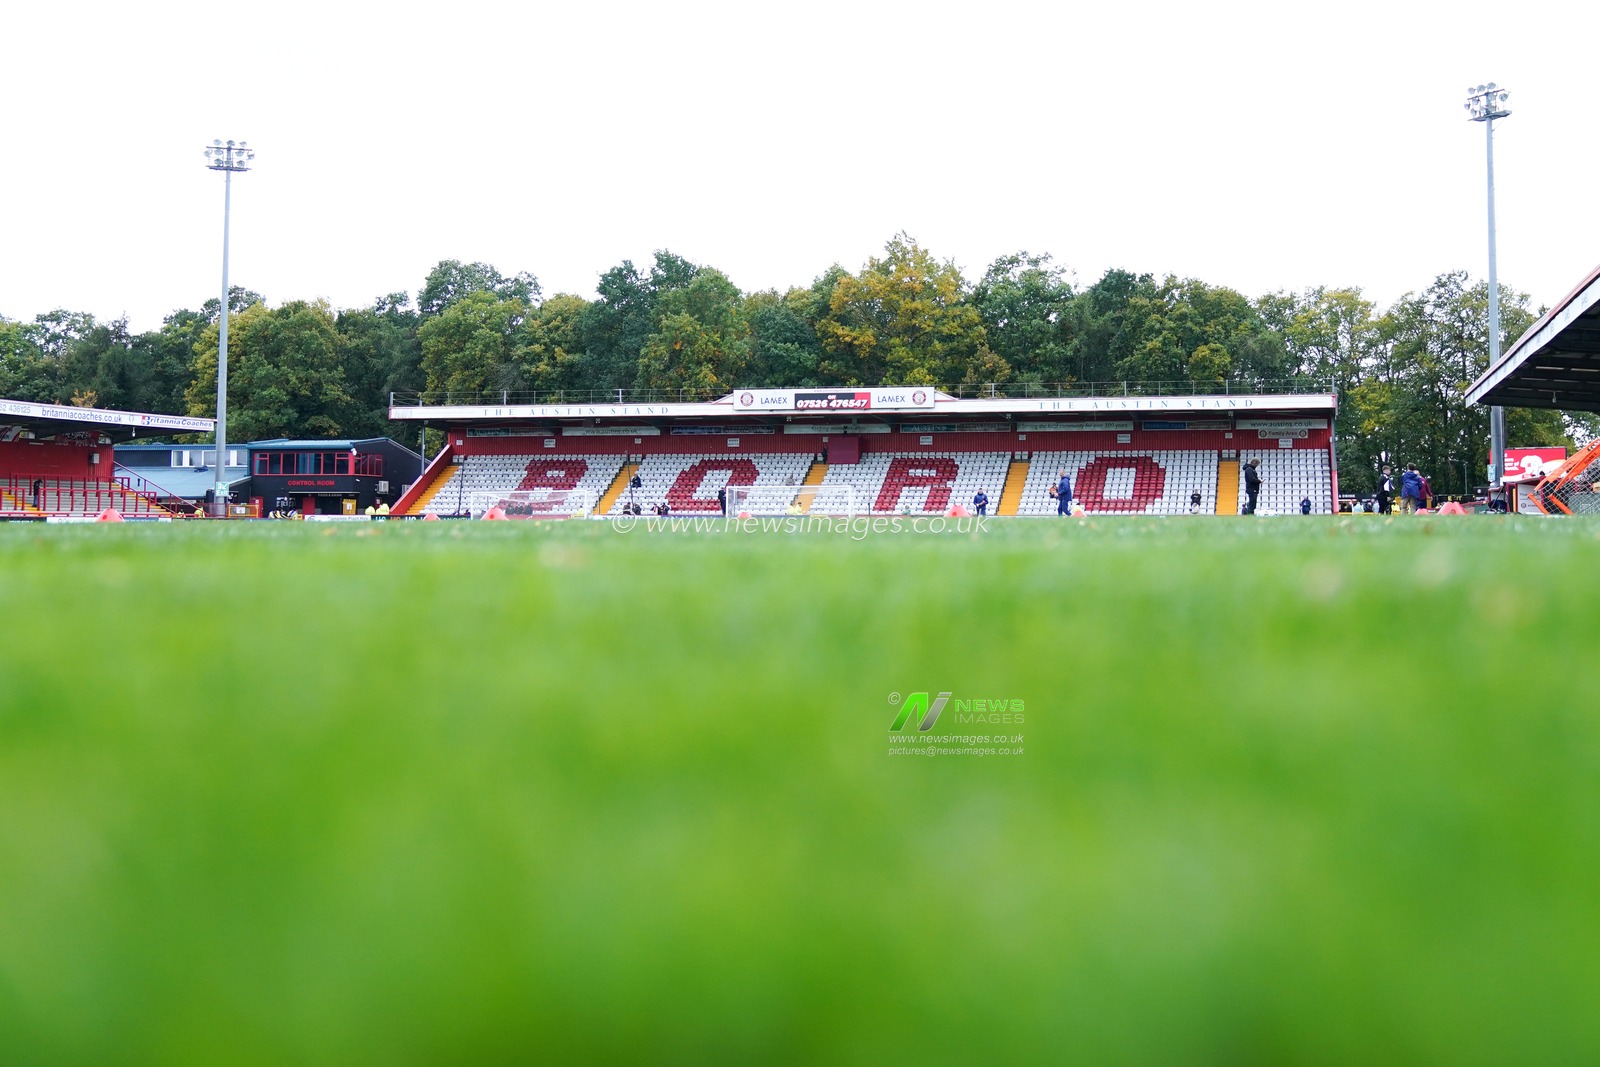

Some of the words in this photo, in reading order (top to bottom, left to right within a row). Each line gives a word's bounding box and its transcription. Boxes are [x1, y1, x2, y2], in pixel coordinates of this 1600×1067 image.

[760, 396, 787, 404] LAMEX
[796, 400, 828, 408] 07526
[829, 399, 868, 408] 476547
[1039, 402, 1075, 410] THE
[1092, 400, 1168, 409] AUSTIN
[1186, 399, 1253, 408] STAND
[9, 404, 31, 414] 436125
[529, 408, 596, 416] AUSTIN
[610, 406, 669, 414] STAND
[42, 407, 122, 422] britanniacoaches.co.uk
[181, 418, 212, 428] Coaches
